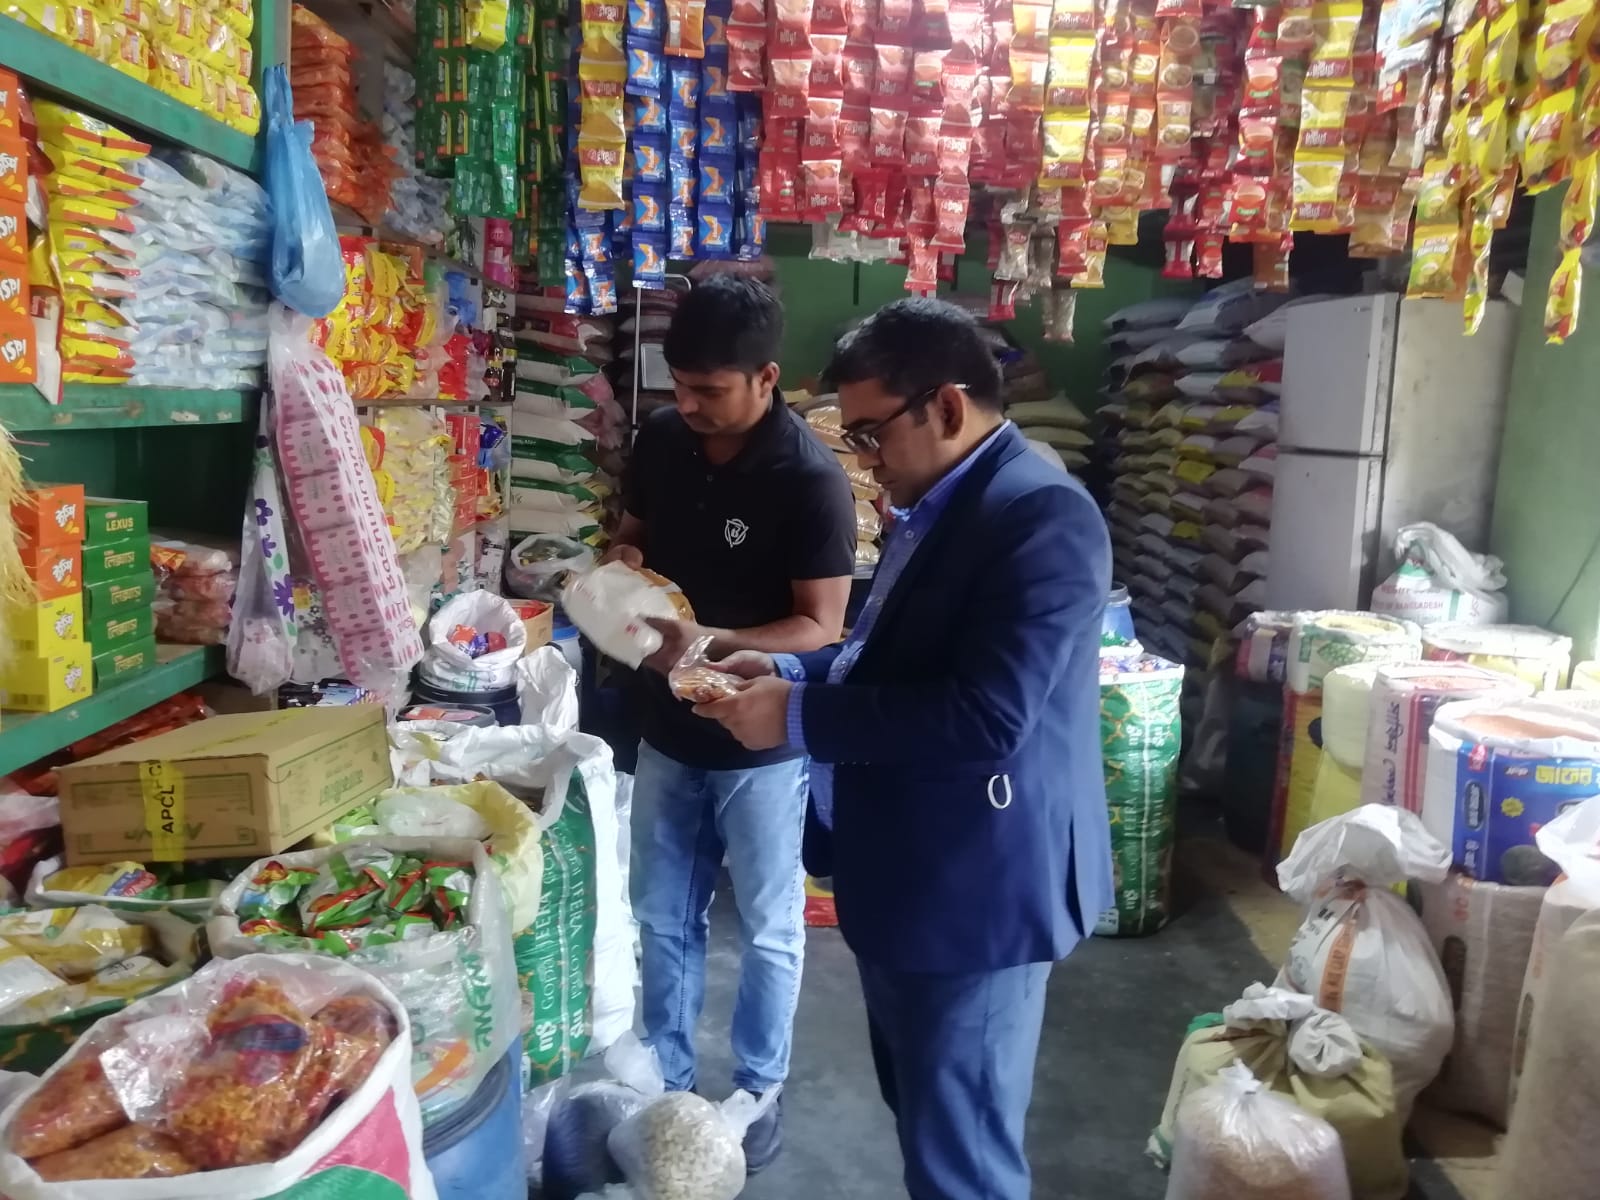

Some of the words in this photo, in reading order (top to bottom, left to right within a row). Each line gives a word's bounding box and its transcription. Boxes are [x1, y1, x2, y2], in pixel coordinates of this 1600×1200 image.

[2, 338, 27, 363] ISPI
[106, 517, 134, 532] LEXUS
[160, 784, 175, 834] APCL
